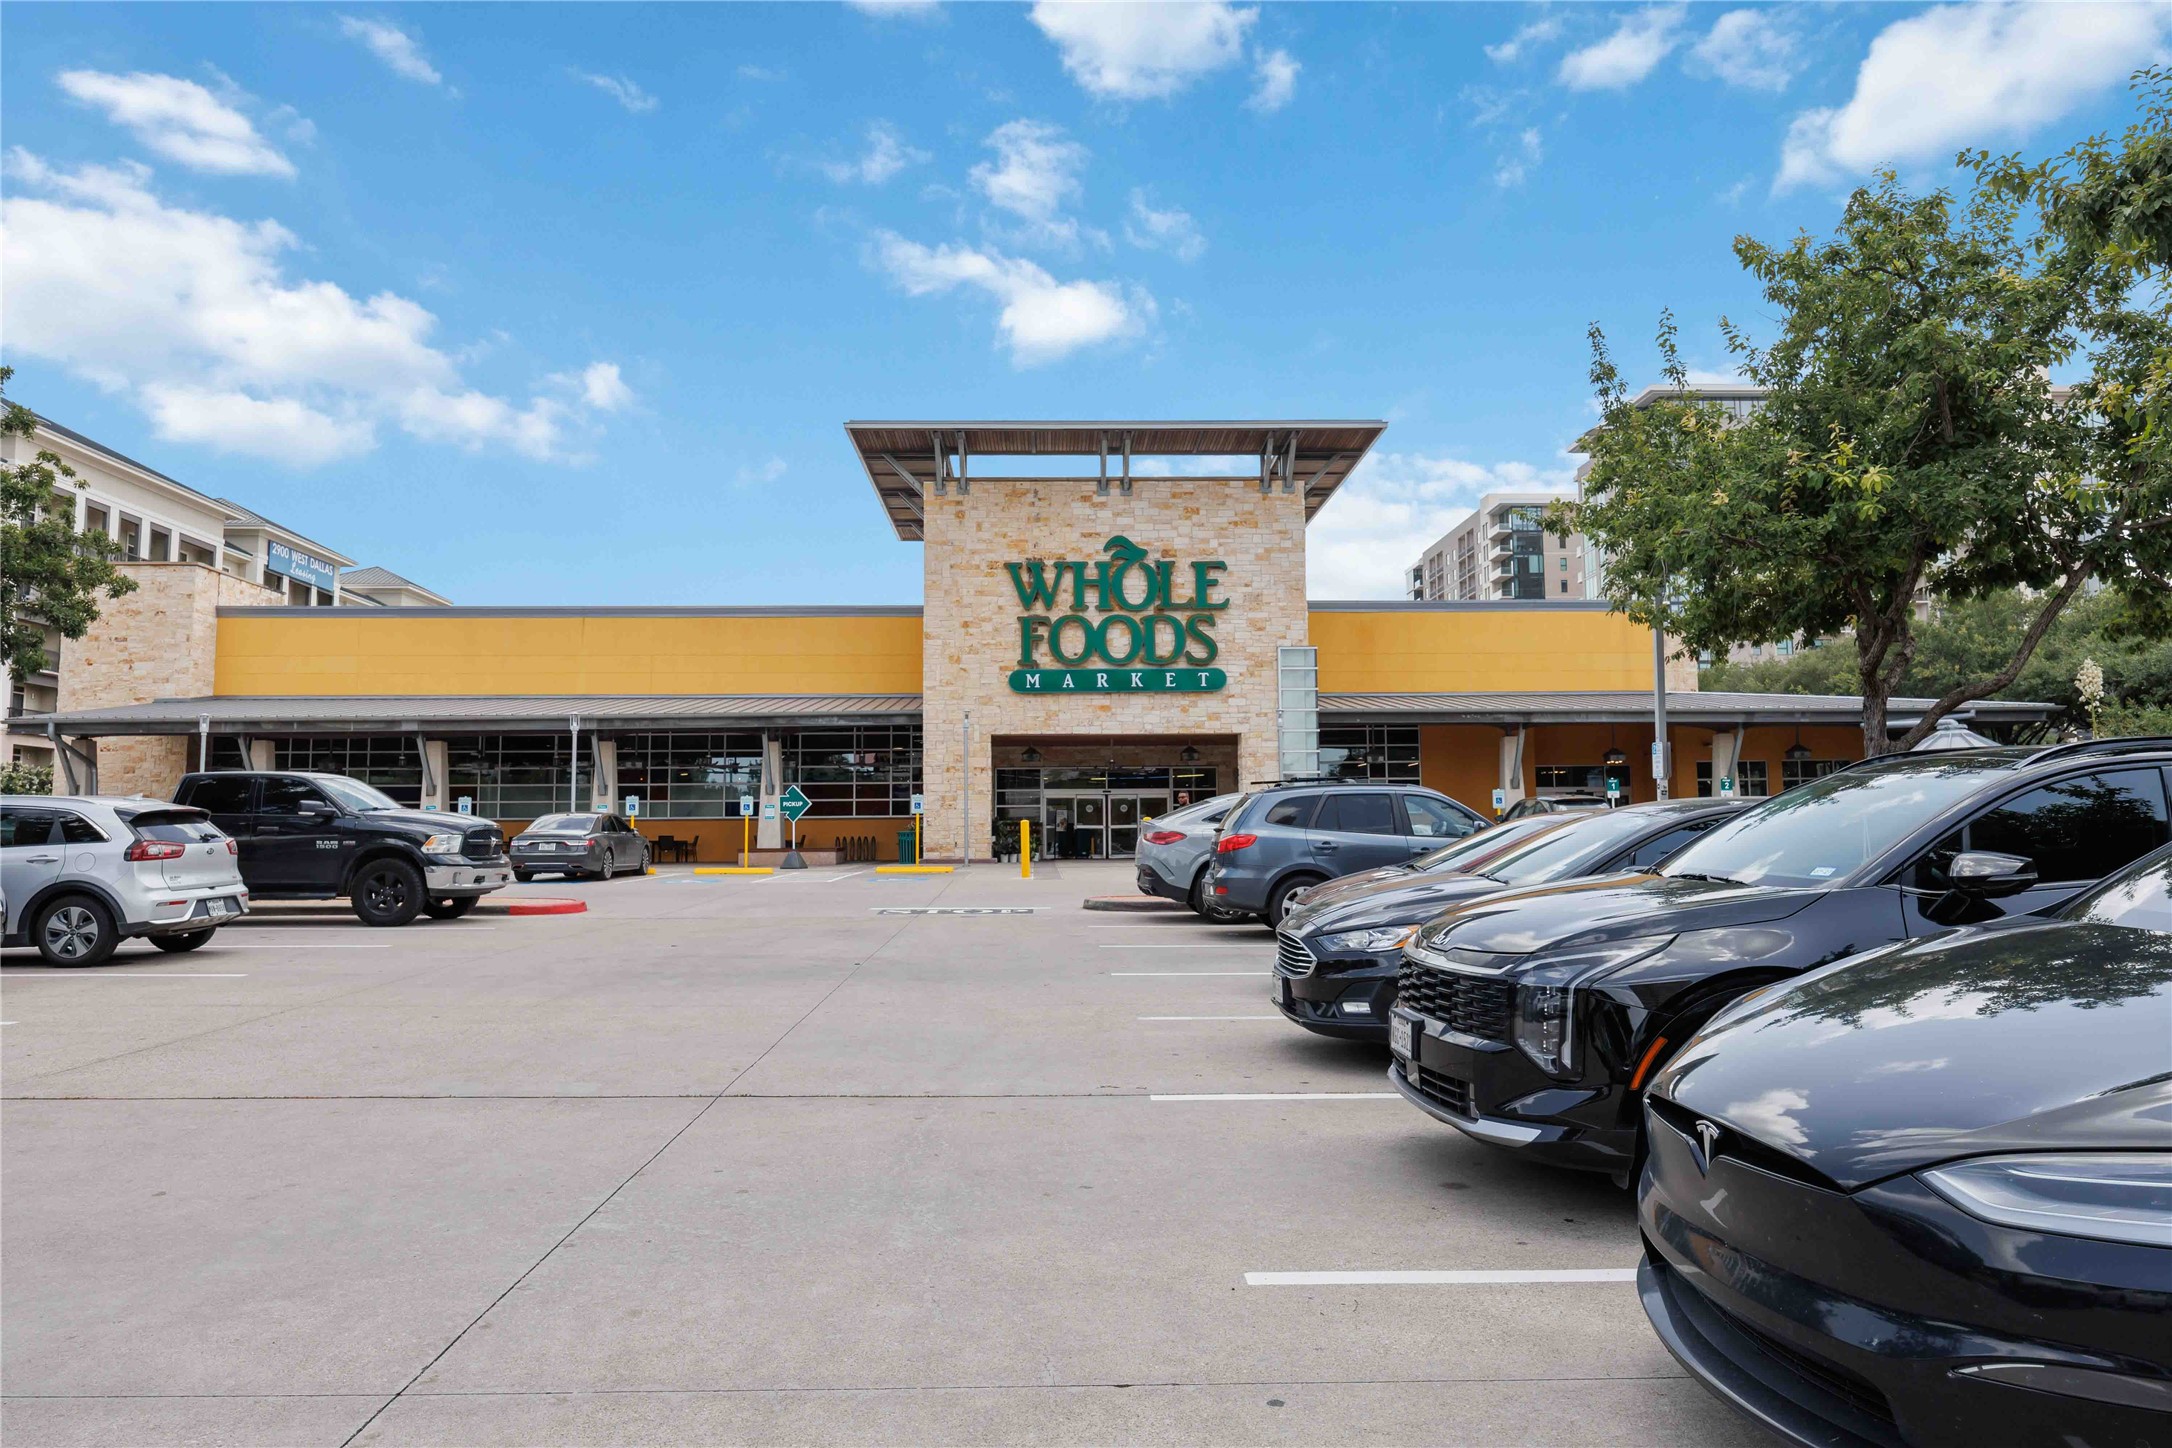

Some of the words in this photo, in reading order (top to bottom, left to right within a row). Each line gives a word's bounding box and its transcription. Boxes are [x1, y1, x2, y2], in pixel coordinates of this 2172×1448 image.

[272, 543, 290, 559] 2900
[291, 549, 309, 567] WEST
[310, 557, 334, 577] DALLAS
[290, 561, 316, 584] Leasing
[1004, 551, 1231, 612] WHOLE
[1017, 613, 1219, 667] FOODS
[1025, 672, 1210, 688] MARKET
[1724, 782, 1730, 790] 2
